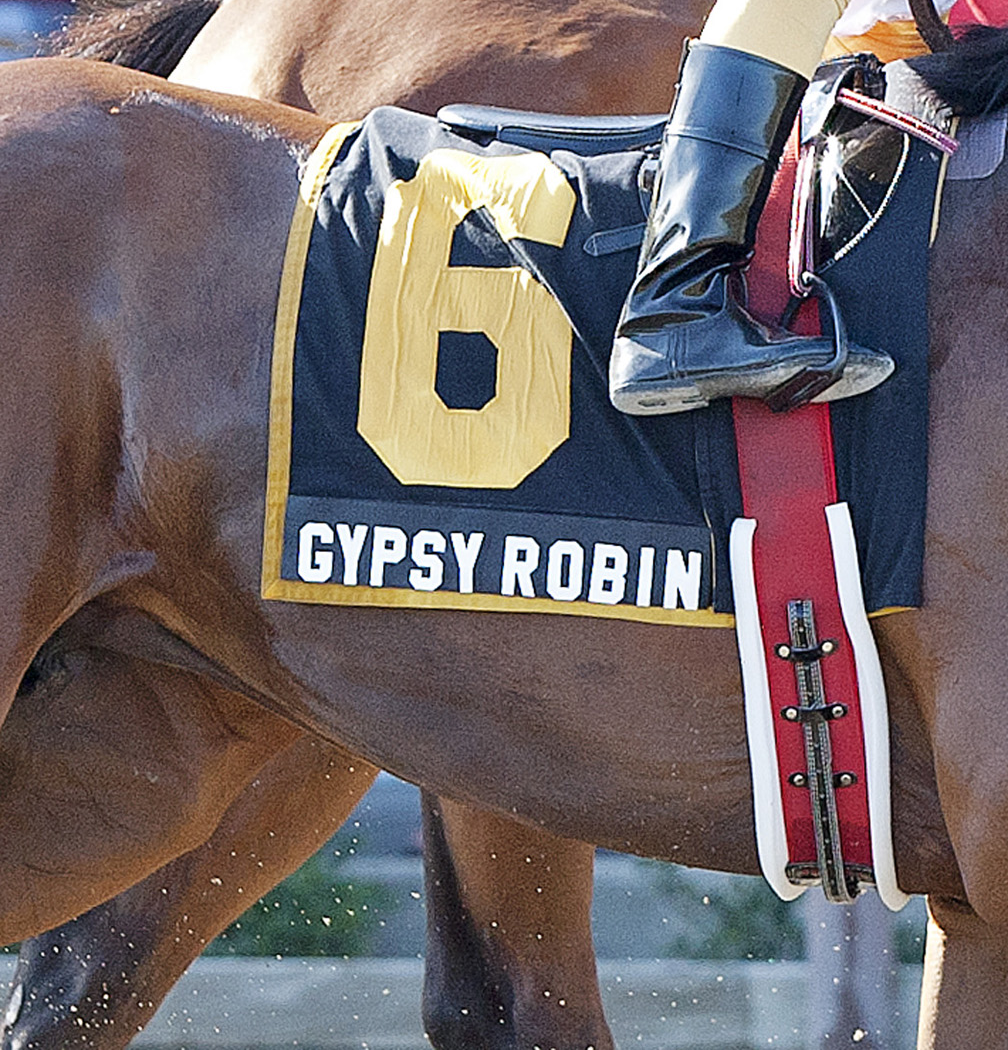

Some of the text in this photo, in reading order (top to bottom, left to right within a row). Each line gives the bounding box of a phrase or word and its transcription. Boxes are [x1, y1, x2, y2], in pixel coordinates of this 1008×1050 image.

[356, 148, 577, 490] 6
[297, 521, 702, 611] GYPSY ROBIN
